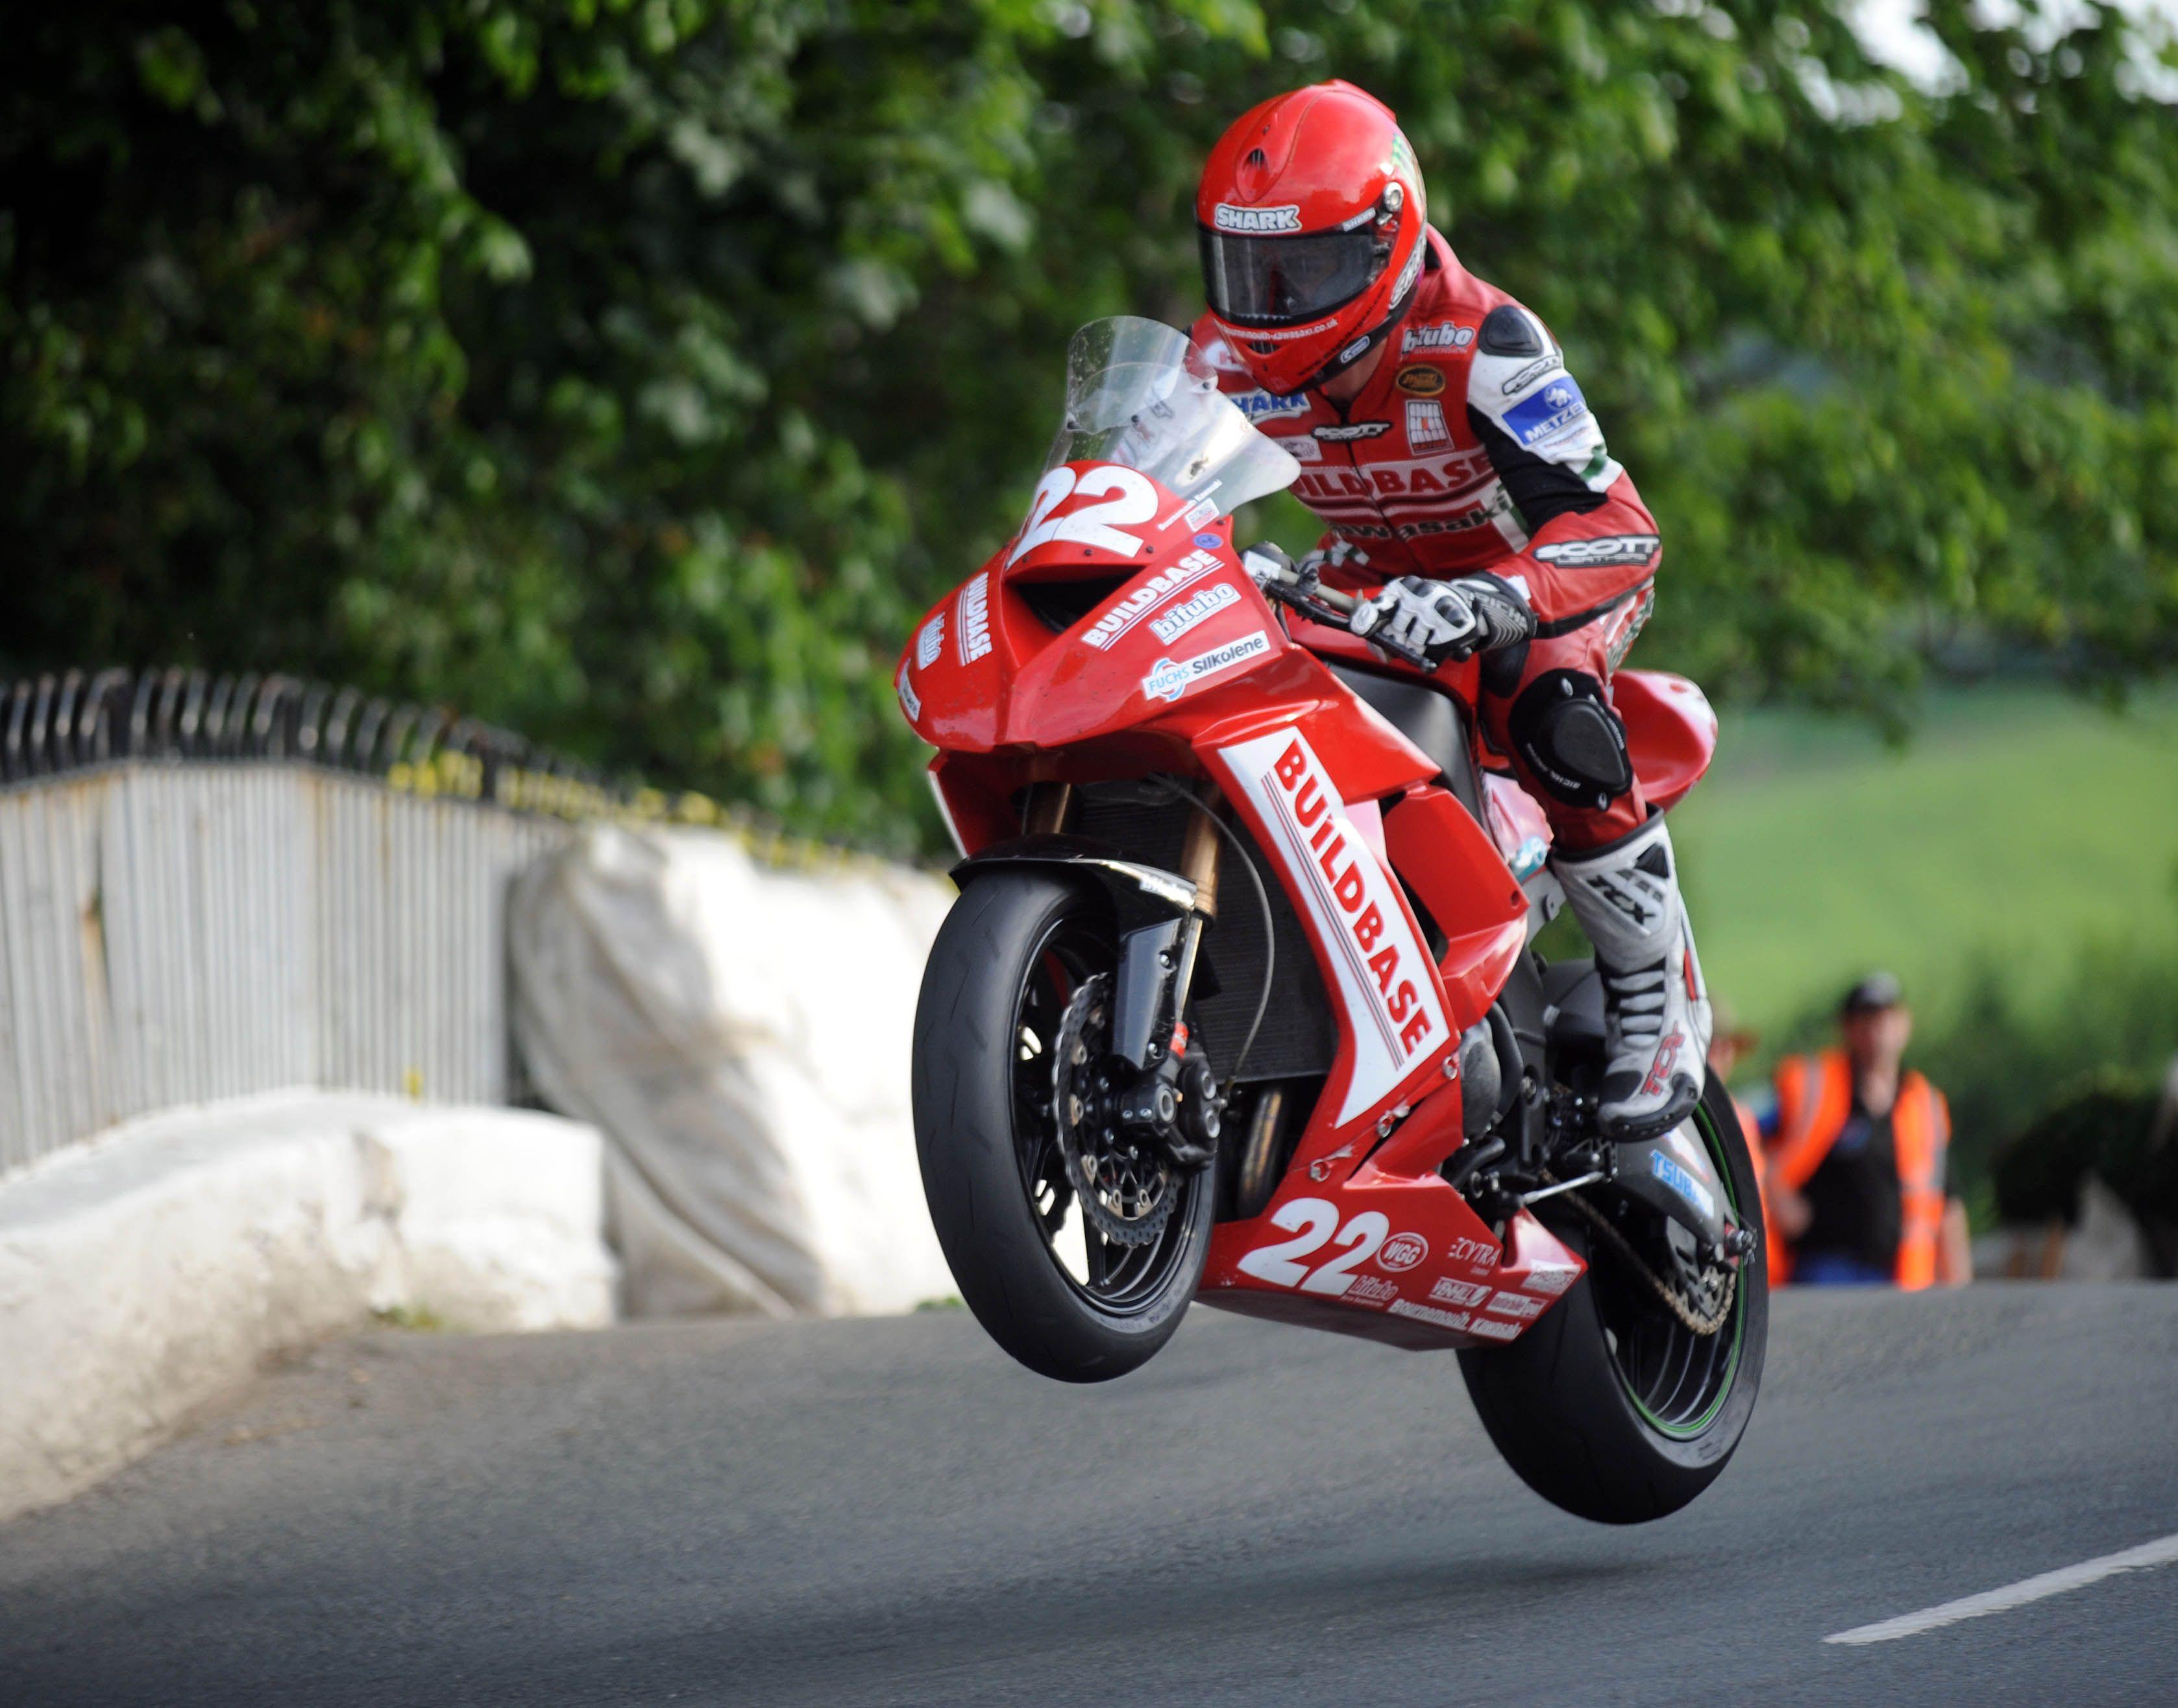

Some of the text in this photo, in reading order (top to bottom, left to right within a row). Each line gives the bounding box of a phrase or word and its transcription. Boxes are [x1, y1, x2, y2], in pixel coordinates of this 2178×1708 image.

[1216, 206, 1299, 230] SHARK
[1230, 391, 1308, 413] HARK
[1525, 400, 1588, 443] METZE
[1289, 452, 1493, 498] ILDBASE
[1007, 465, 1159, 571] 22
[1536, 535, 1660, 559] SCOTT
[1081, 549, 1219, 648] BUILDBASE
[1150, 583, 1236, 640] bitubo
[1148, 637, 1264, 692] FUCHS Silkolene
[1274, 738, 1434, 1058] BUILDBASE
[1236, 1197, 1390, 1296] 22
